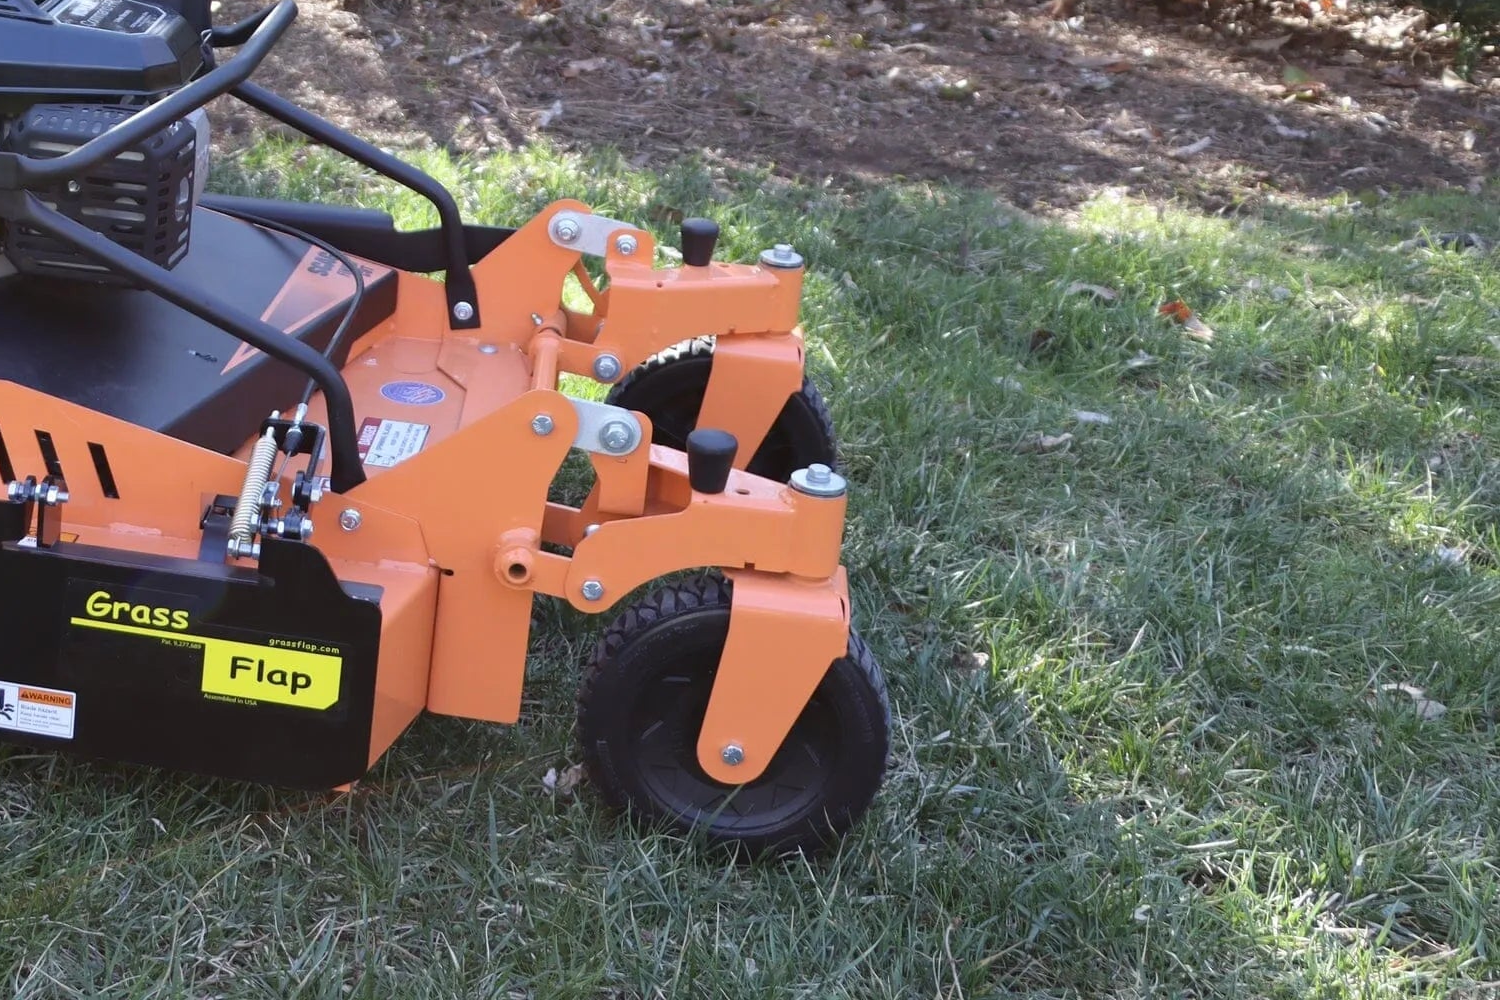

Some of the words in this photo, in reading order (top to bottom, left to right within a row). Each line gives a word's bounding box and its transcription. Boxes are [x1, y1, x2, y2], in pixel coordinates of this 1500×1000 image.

[86, 590, 189, 630] Grass
[268, 638, 340, 654] grassflap.com
[230, 655, 312, 695] Flap
[27, 691, 71, 705] WARNING
[203, 693, 237, 703] Assembled
